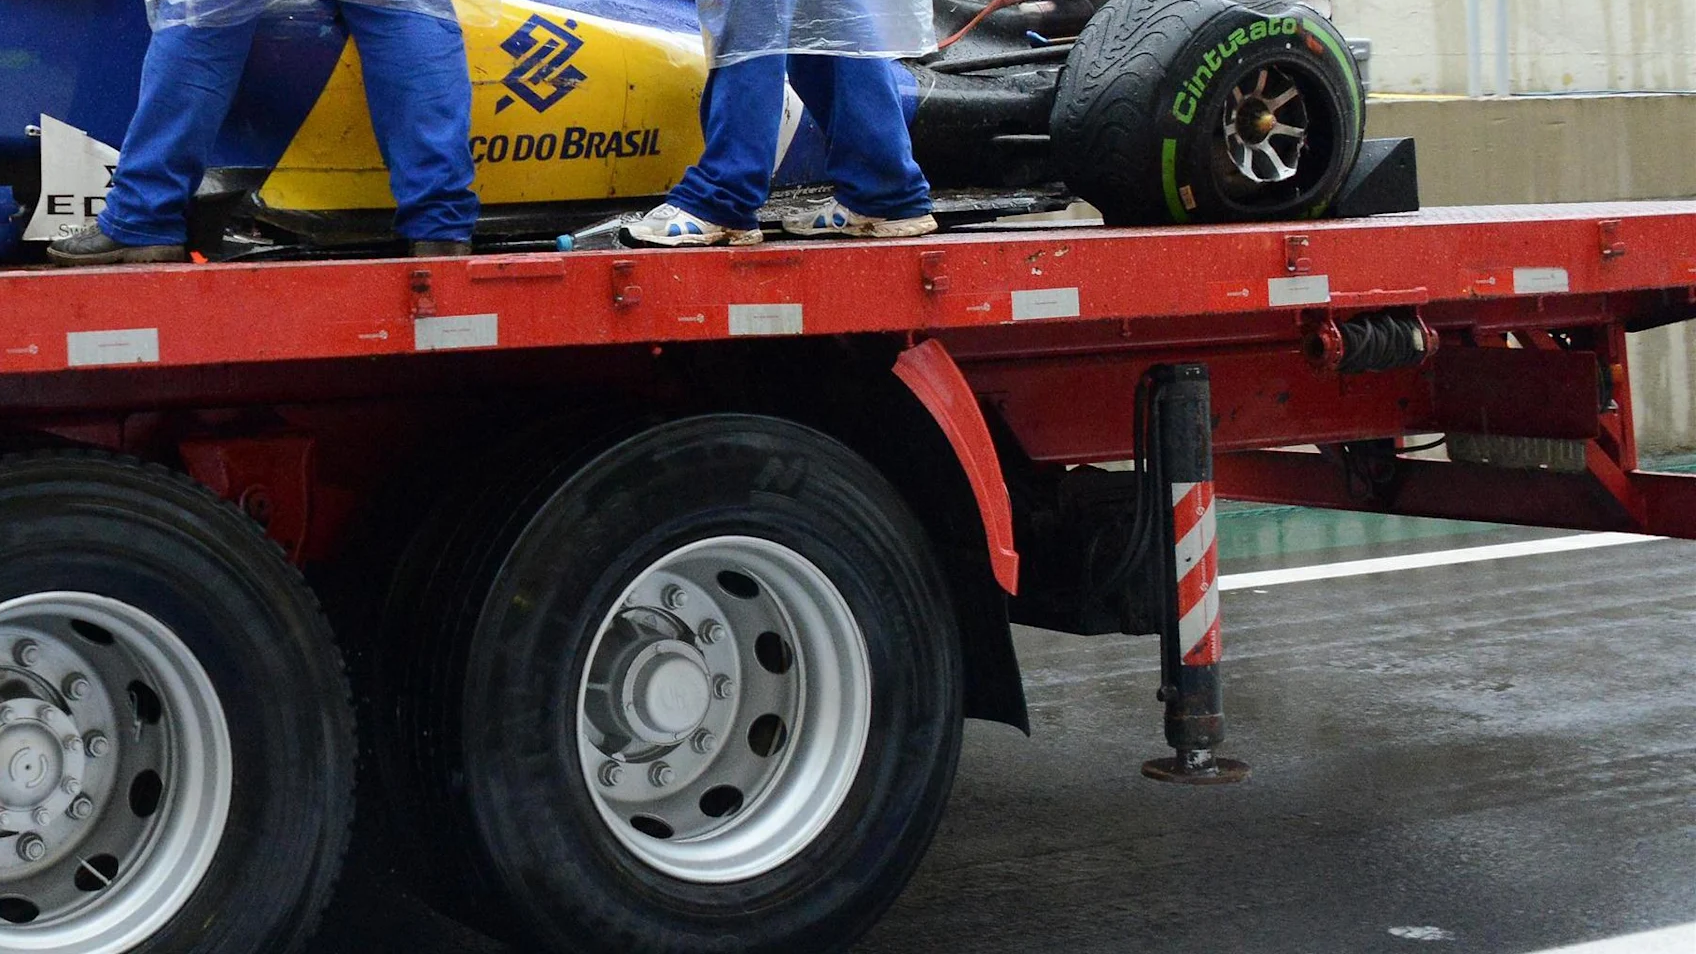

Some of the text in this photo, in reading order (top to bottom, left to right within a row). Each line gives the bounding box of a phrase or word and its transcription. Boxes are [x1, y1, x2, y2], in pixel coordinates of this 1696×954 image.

[1172, 17, 1297, 124] Cinturato
[470, 127, 661, 163] CO DO BRASIL
[47, 195, 107, 217] ED
